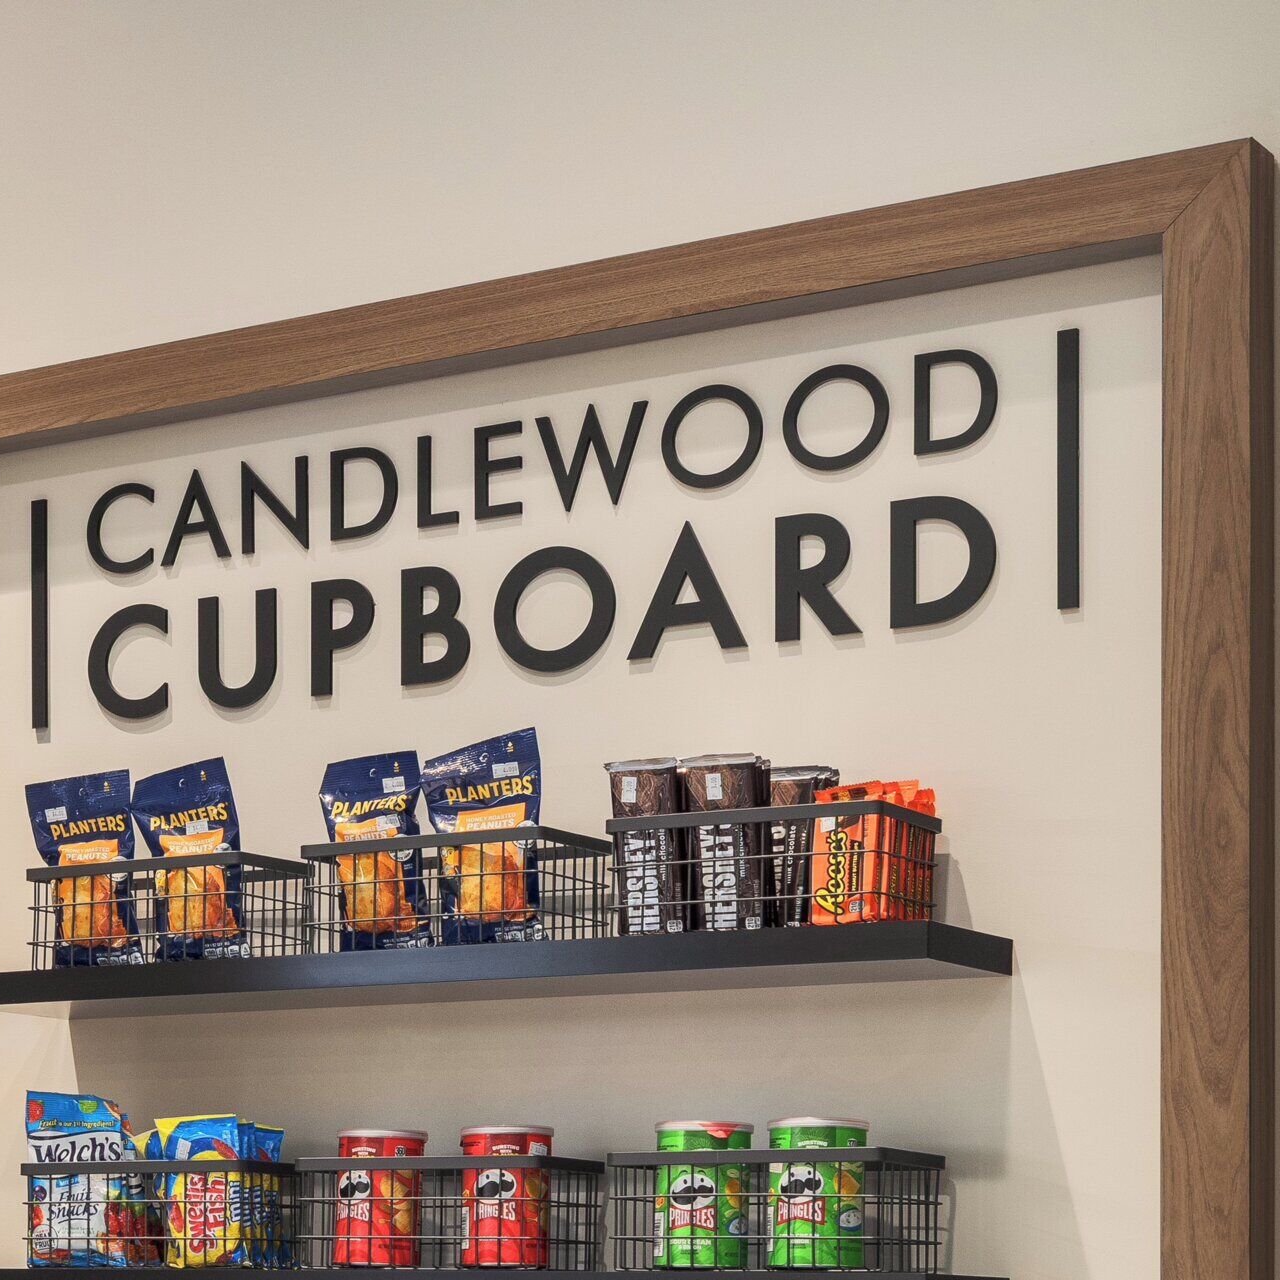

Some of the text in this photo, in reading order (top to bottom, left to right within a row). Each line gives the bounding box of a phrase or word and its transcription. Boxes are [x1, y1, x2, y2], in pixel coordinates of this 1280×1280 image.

[86, 349, 998, 575] CANDLEWOOD
[87, 495, 997, 719] CUPBOARD
[446, 775, 533, 805] PLANTERS
[150, 803, 228, 831] PLANTERS
[331, 795, 408, 819] PLANTERS
[50, 814, 125, 840] PLANTERS
[466, 819, 515, 830] PEANUTS
[66, 853, 108, 861] PEANUTS
[170, 843, 213, 853] PEANUTS
[32, 1136, 121, 1162] Welch's
